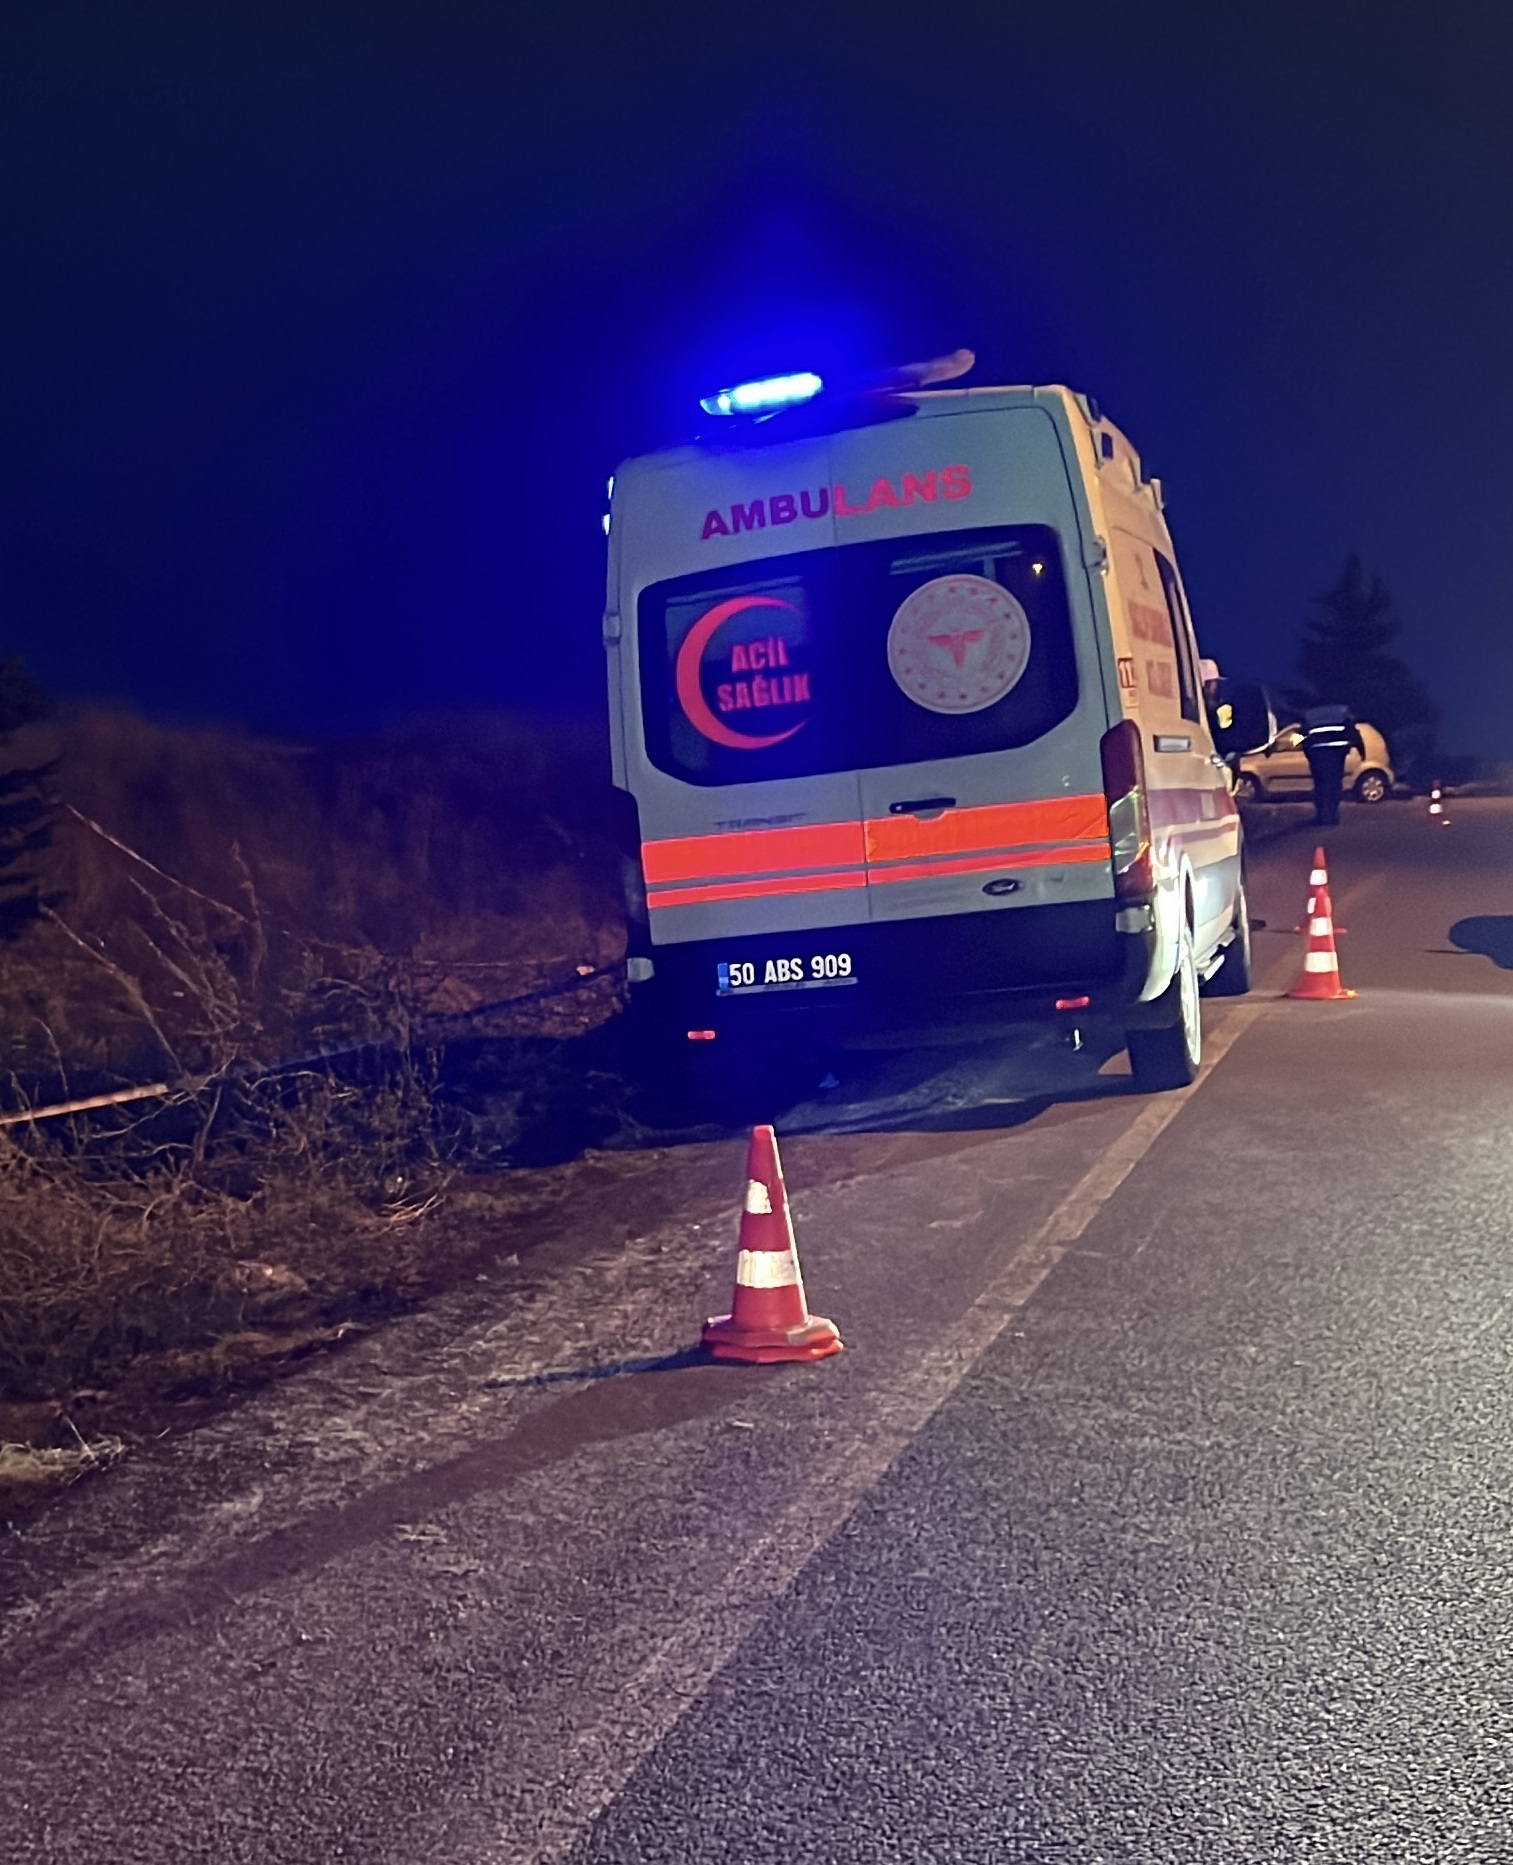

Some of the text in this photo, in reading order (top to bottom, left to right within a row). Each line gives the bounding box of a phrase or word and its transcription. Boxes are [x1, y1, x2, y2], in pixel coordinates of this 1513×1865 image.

[701, 465, 973, 540] AMBULANS
[731, 639, 788, 672] ACİL
[717, 675, 810, 712] SAĞLIK
[729, 962, 755, 986] 50
[764, 957, 804, 984] ABS
[811, 953, 852, 978] 909
